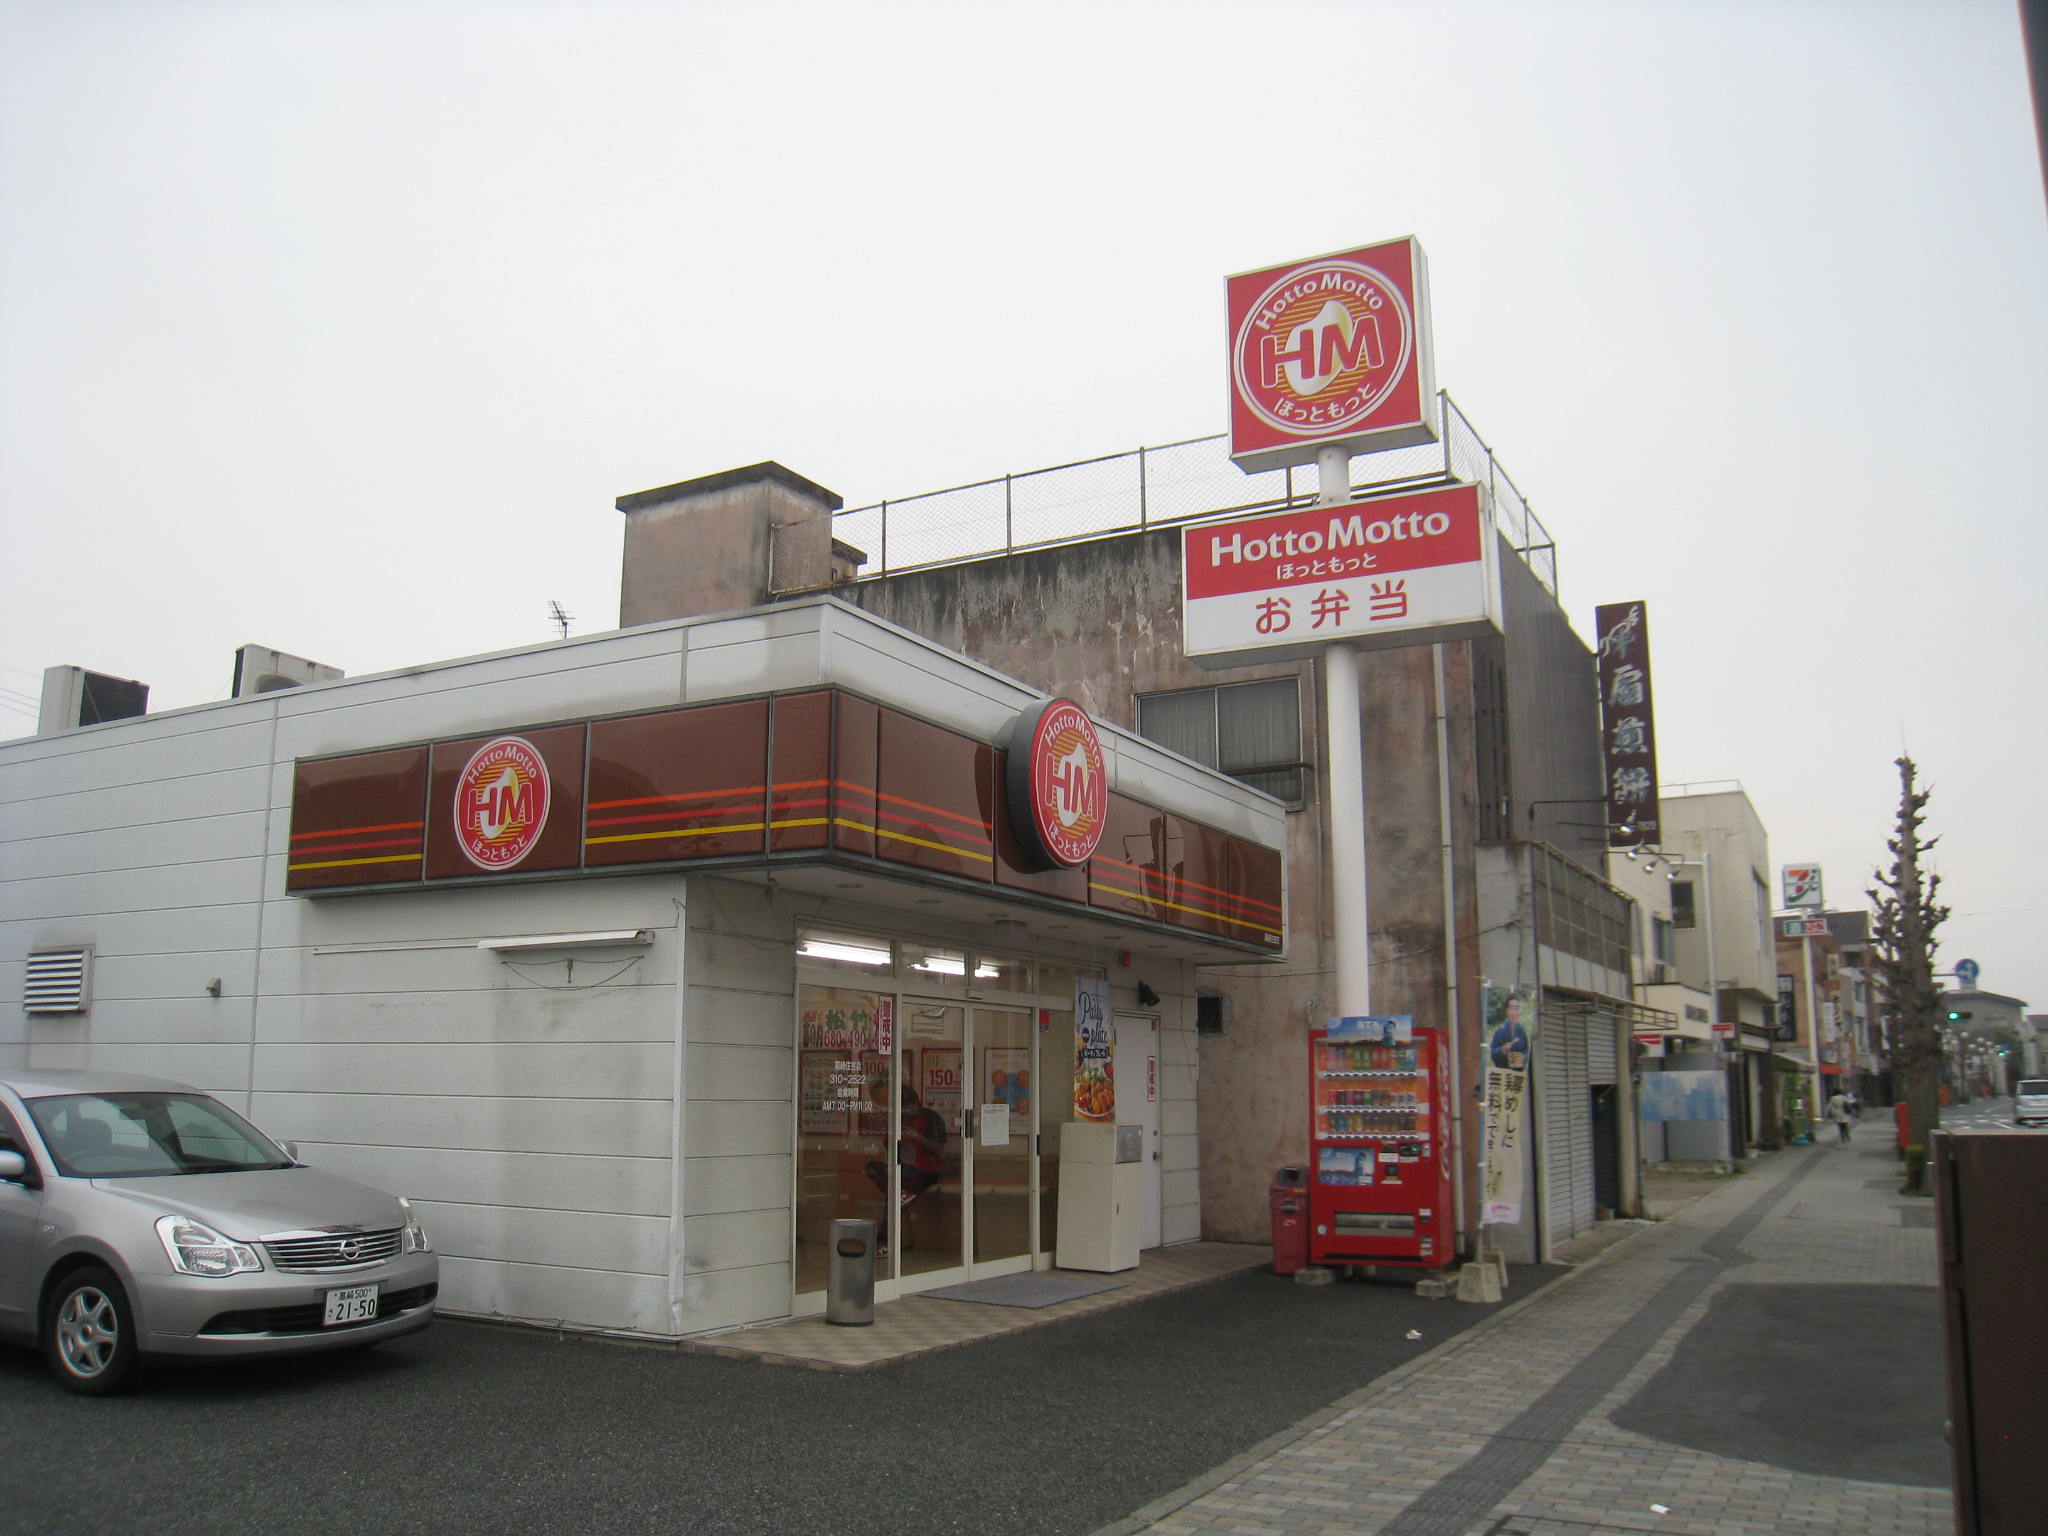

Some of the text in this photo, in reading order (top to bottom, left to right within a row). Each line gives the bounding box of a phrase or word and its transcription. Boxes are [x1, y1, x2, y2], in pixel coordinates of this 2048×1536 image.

[1260, 314, 1384, 388] HM
[1273, 382, 1377, 422] ほっともっと
[1276, 552, 1378, 581] ほっともっと
[1255, 578, 1408, 635] お弁当
[466, 781, 534, 830] HM
[1045, 753, 1099, 823] HM
[471, 834, 528, 861] ほっともっと
[1049, 823, 1094, 858] ほっともっと
[829, 1074, 866, 1085] 310-2522
[336, 1298, 376, 1321] 21-50
